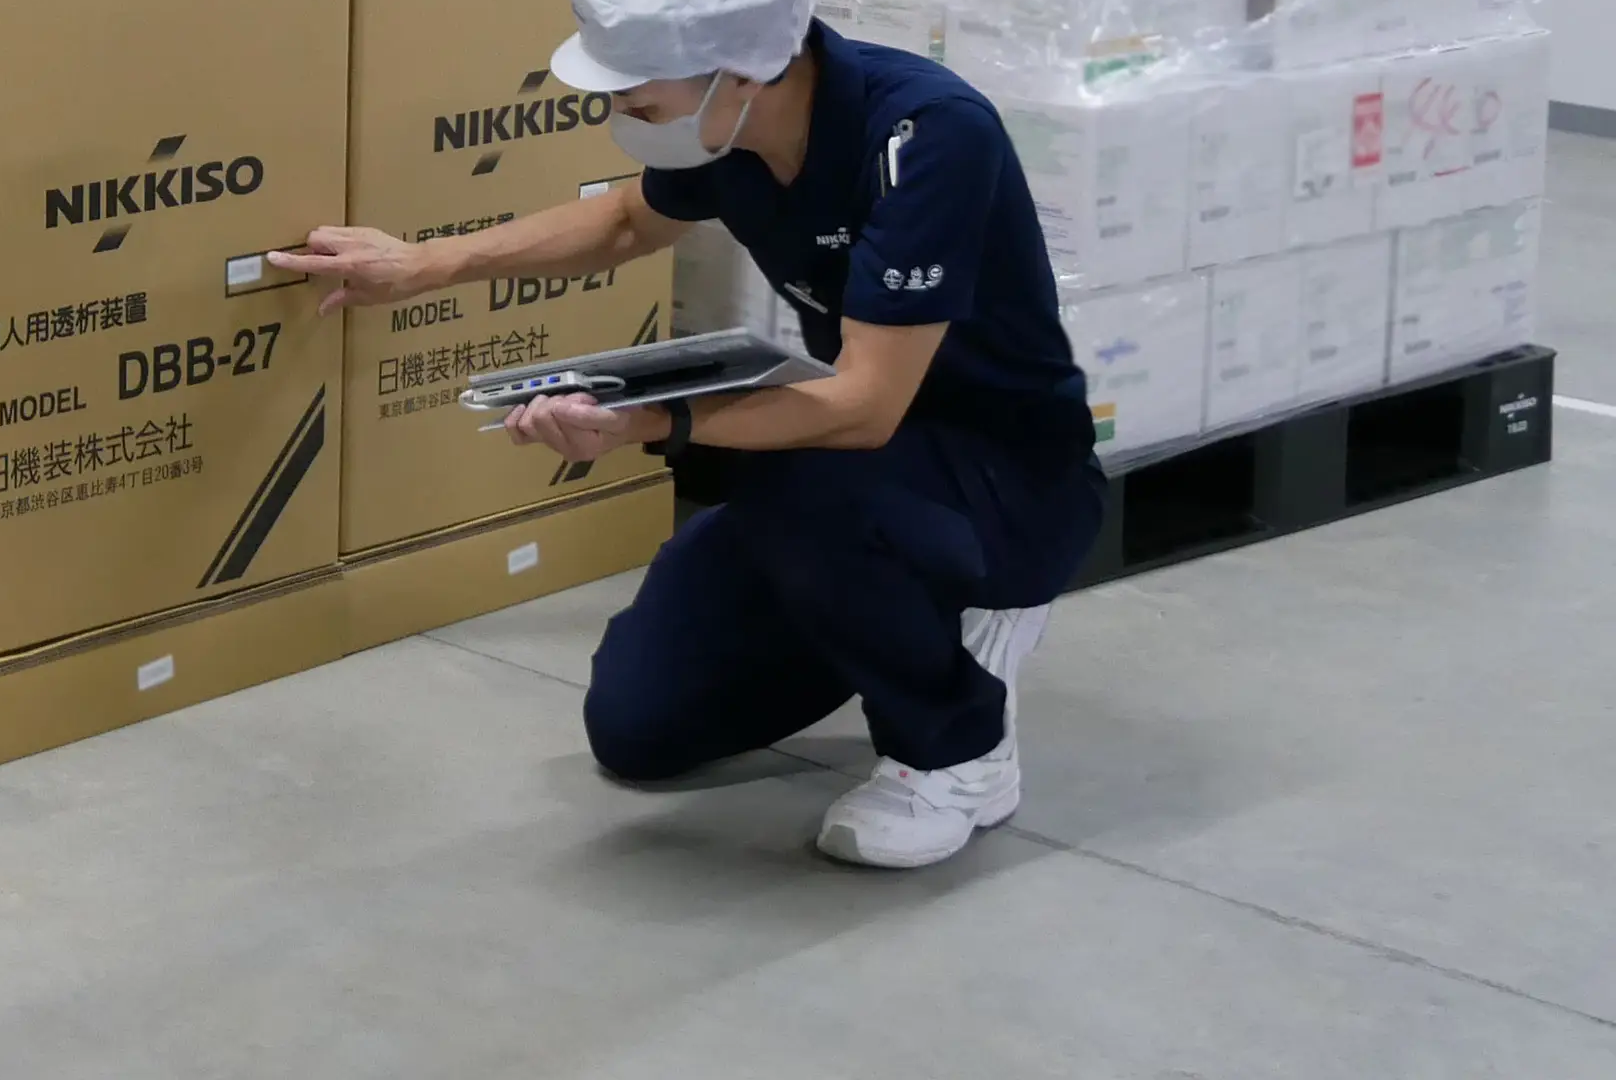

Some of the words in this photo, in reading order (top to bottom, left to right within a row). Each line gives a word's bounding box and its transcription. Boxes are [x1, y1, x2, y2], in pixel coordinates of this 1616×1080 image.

[434, 91, 612, 153] NIKKISO
[45, 156, 264, 229] NIKKISO
[391, 297, 464, 333] MODEL
[118, 322, 282, 401] DBB-27
[378, 324, 550, 395] 日機装株式会社
